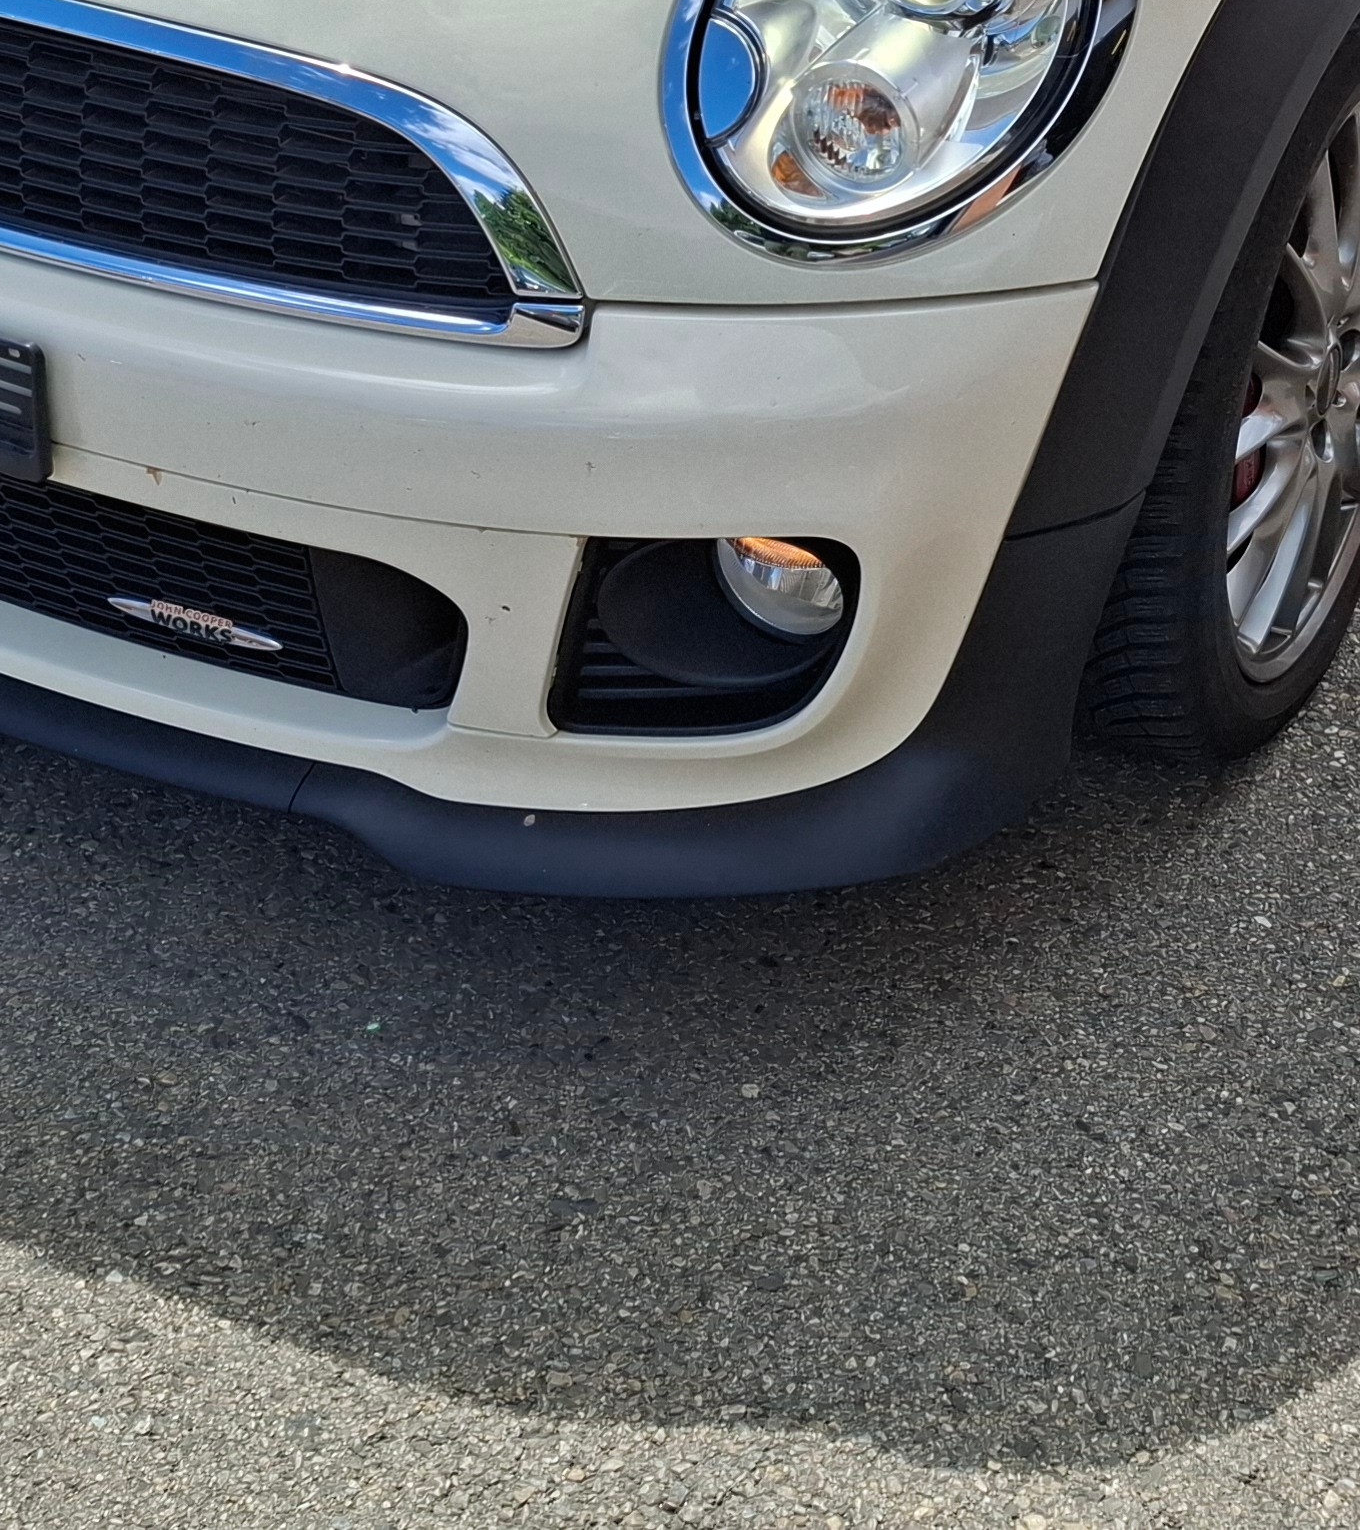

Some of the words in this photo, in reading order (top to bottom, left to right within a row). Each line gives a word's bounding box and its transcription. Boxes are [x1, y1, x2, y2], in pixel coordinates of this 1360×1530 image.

[151, 599, 183, 615] JOHN
[185, 608, 232, 628] COOPER
[151, 609, 233, 643] WORKS
